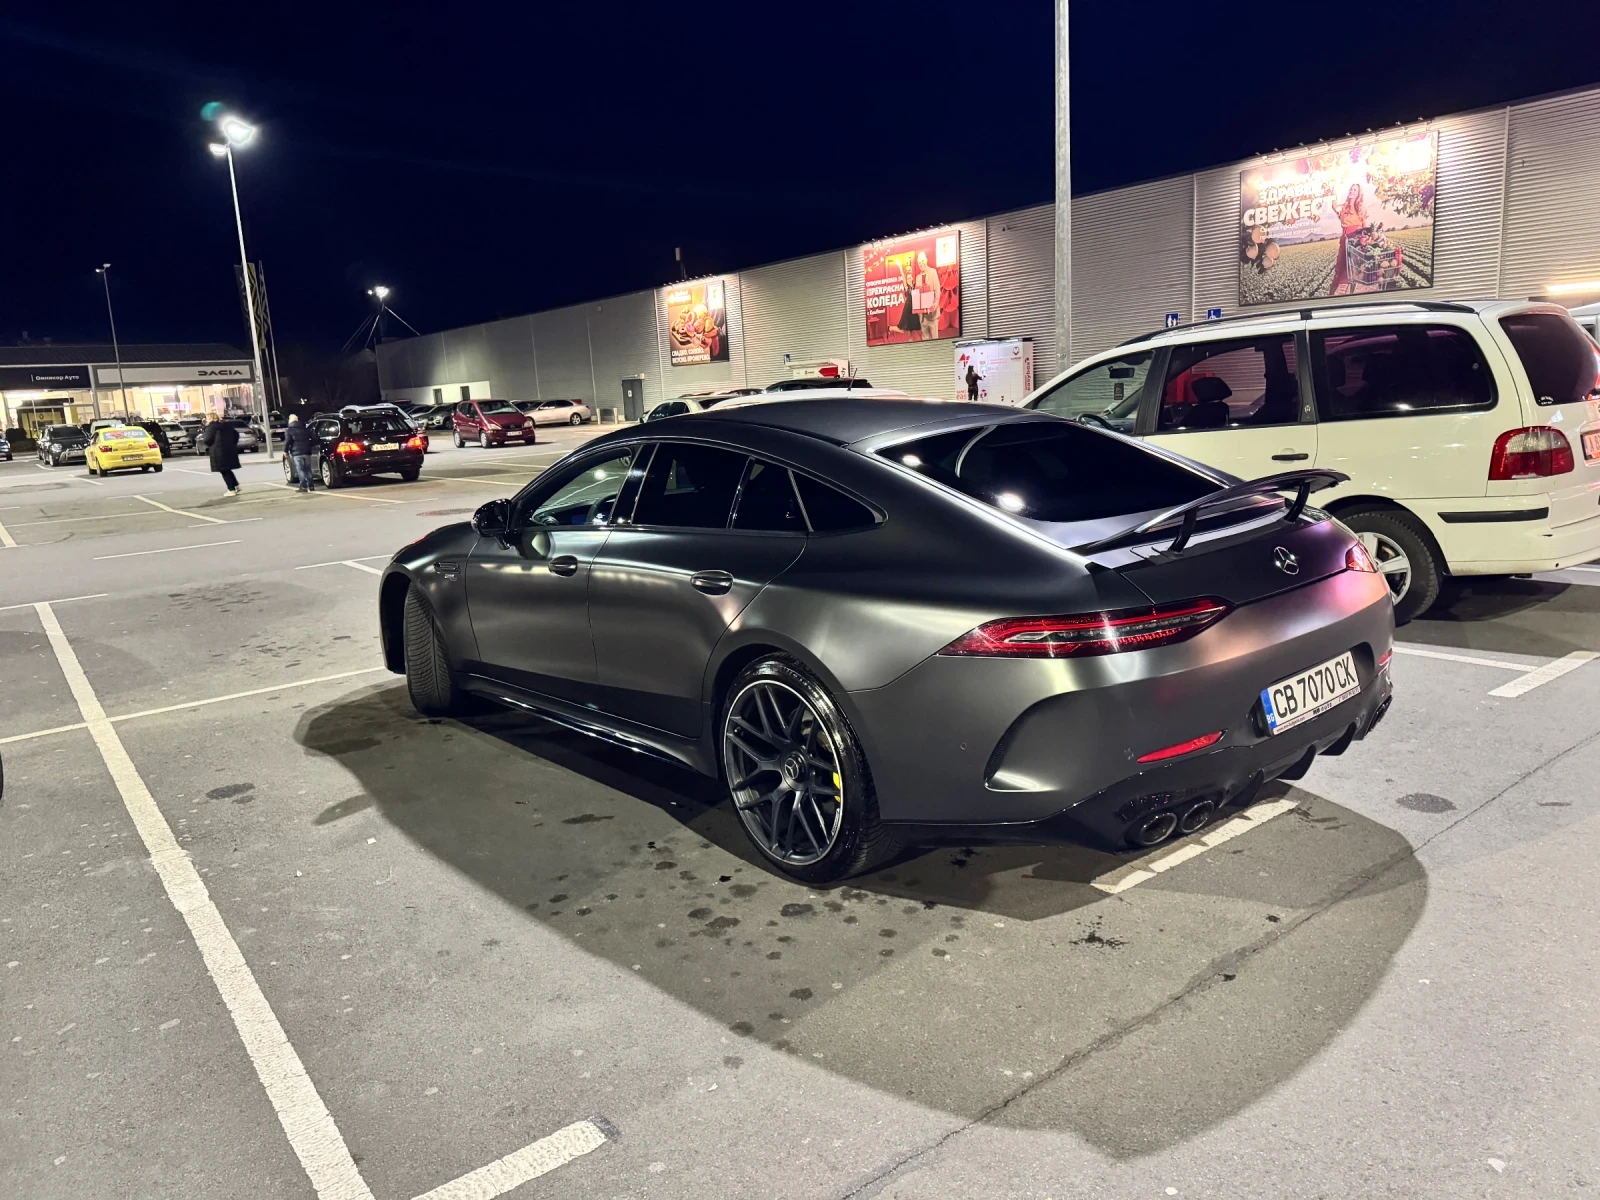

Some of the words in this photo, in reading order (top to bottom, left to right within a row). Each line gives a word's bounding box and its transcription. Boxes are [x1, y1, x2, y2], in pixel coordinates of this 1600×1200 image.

[866, 283, 905, 296] ПРЕКРАСНА
[867, 293, 905, 309] КОЛЕДА
[1273, 684, 1298, 718] CB
[1296, 666, 1335, 708] 7070
[1334, 656, 1356, 688] CK
[1266, 713, 1275, 723] BG
